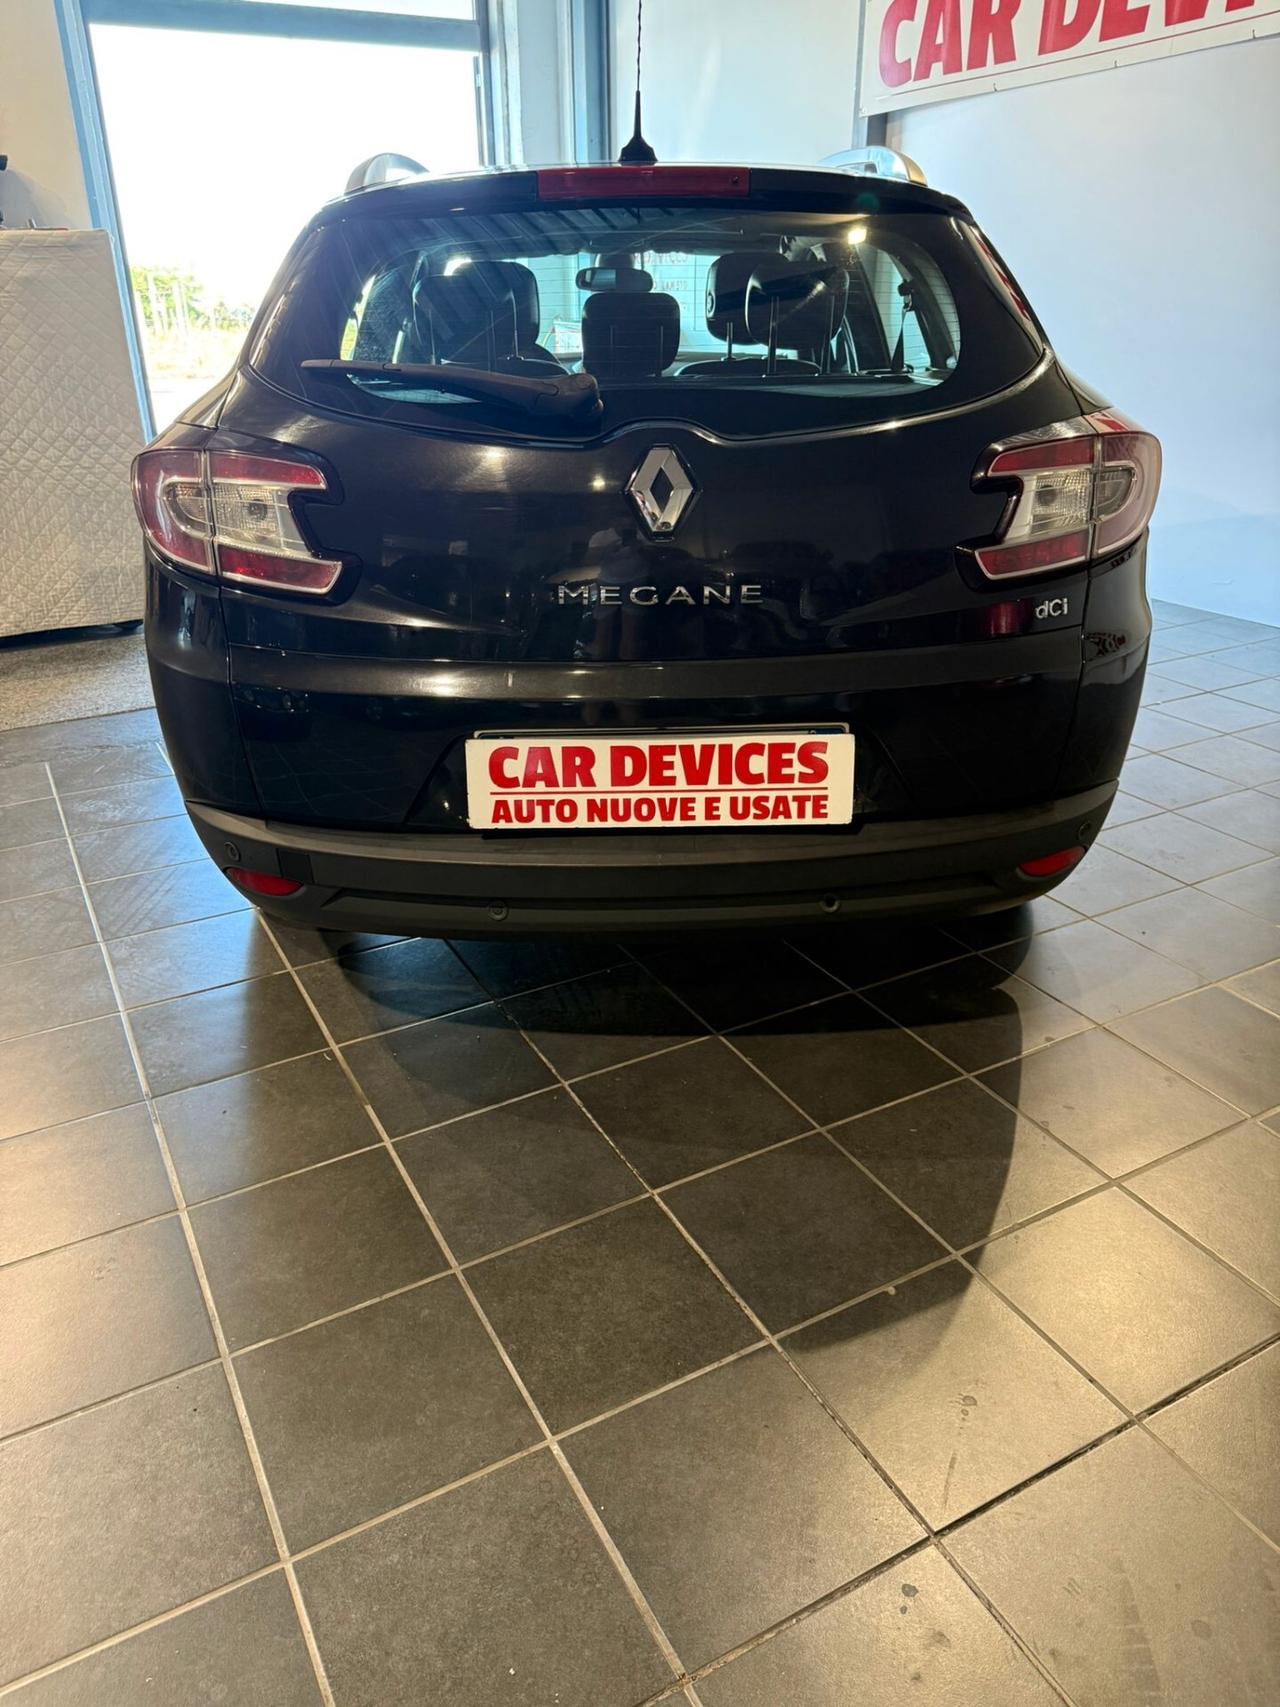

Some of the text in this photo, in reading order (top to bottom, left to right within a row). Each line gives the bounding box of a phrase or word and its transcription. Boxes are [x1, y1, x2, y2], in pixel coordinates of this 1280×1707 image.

[878, 0, 1021, 88] CAR
[557, 584, 764, 605] MEGANE
[1035, 597, 1069, 619] dCi
[488, 741, 829, 789] CAR DEVICES
[491, 794, 829, 824] AUTO NUOVE E USATE
